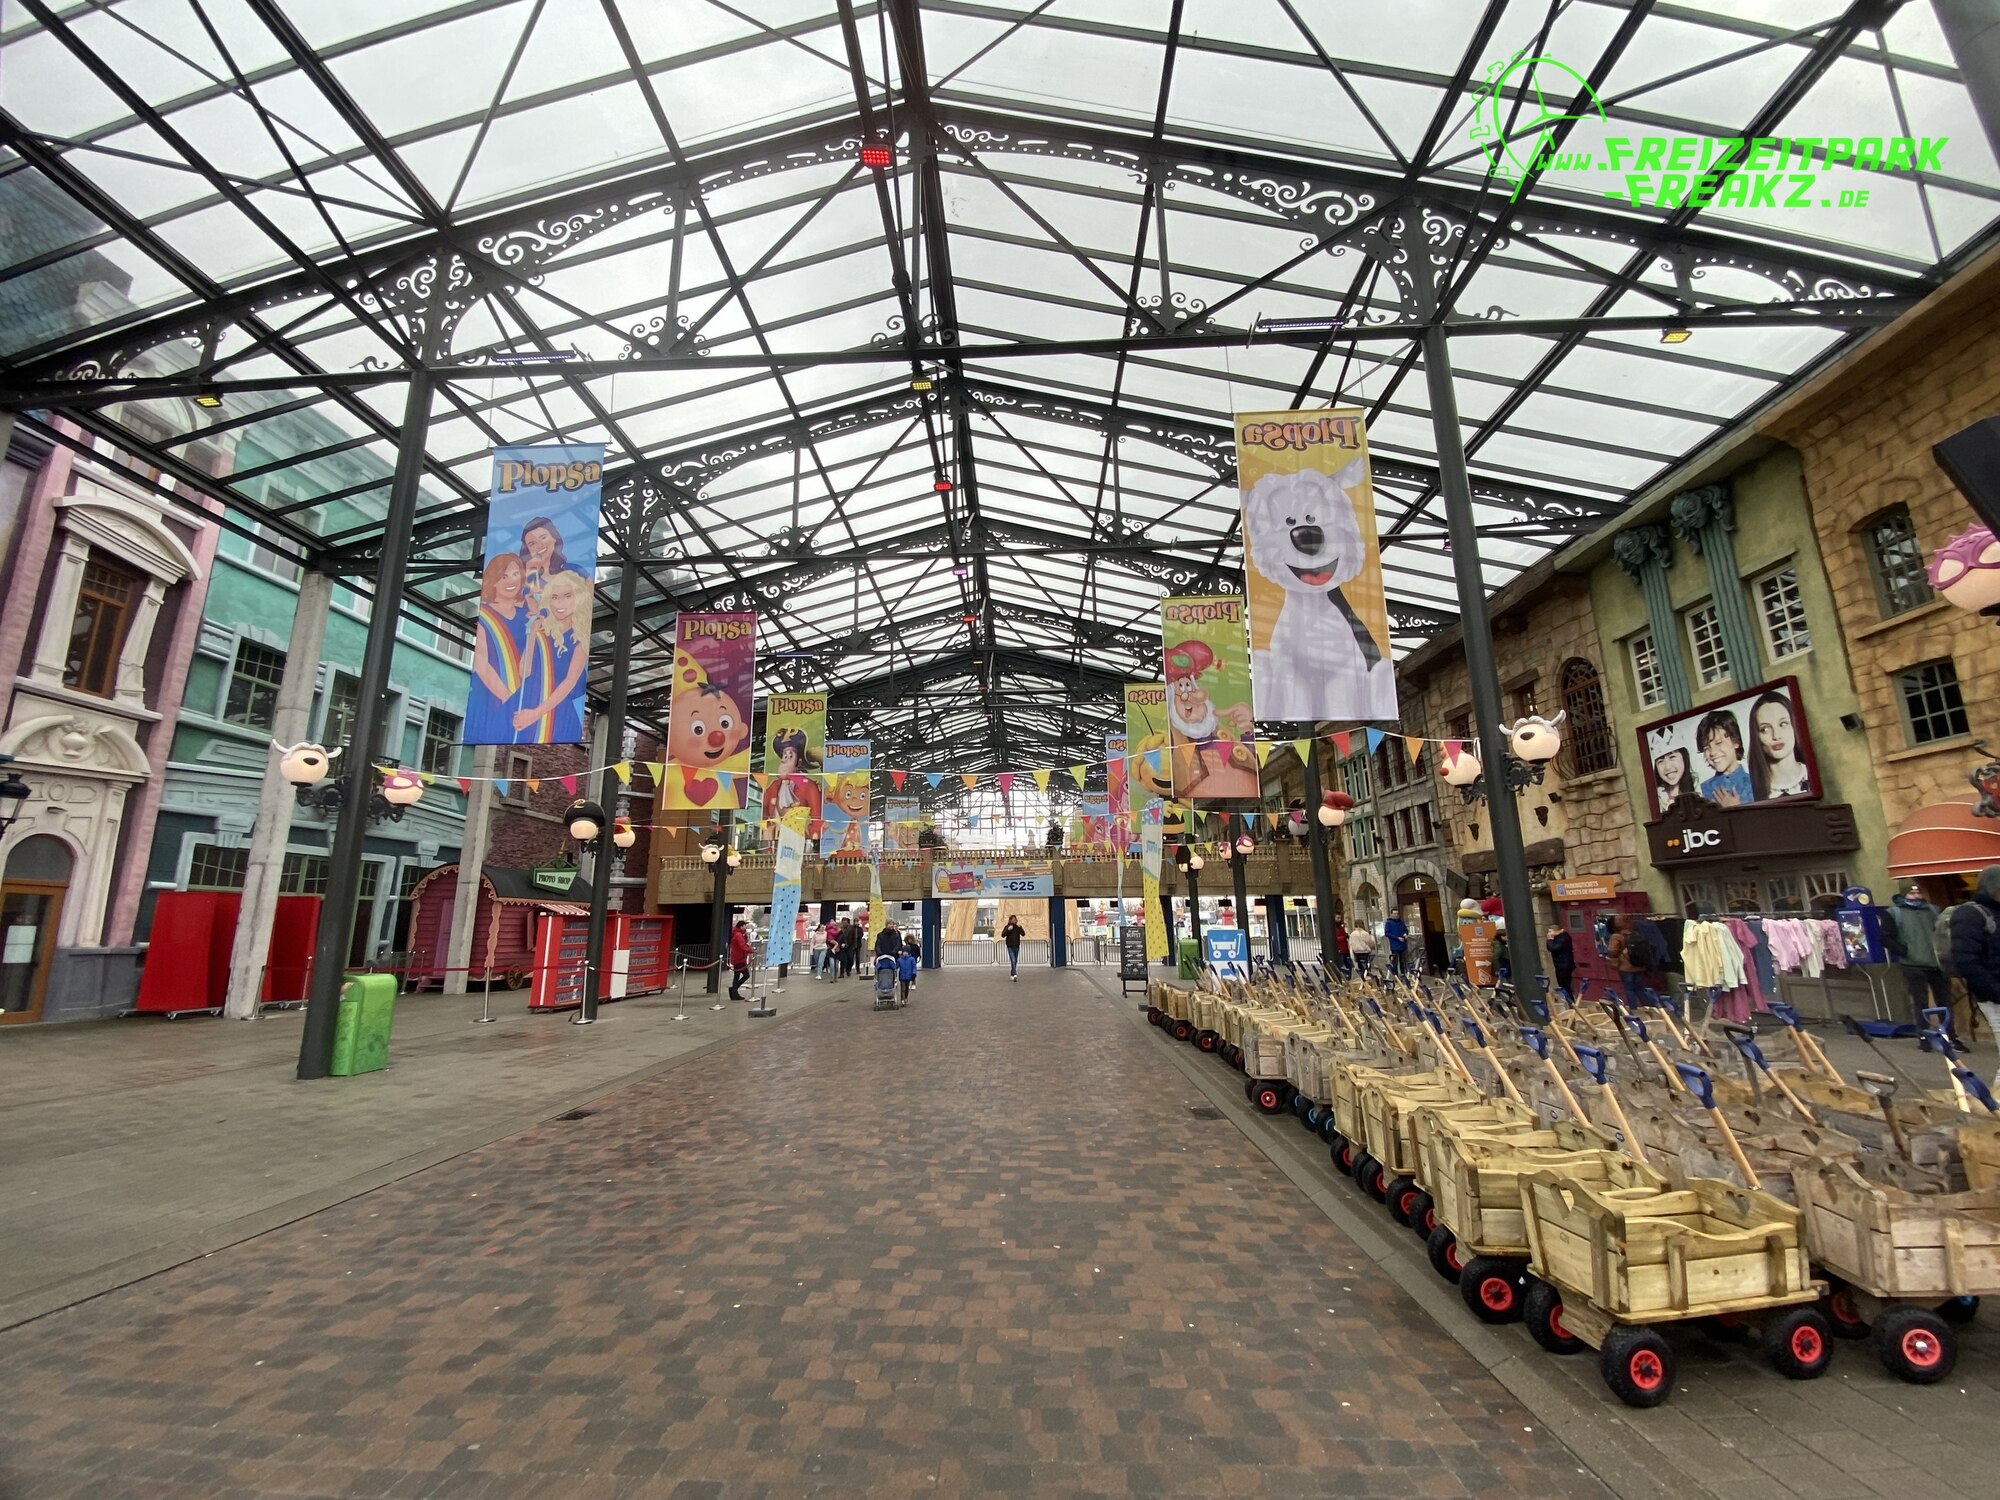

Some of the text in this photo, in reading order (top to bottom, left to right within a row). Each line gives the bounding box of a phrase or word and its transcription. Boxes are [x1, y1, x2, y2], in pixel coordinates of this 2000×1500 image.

[496, 460, 602, 493] Plopsa
[681, 619, 753, 641] Plopsa
[771, 698, 824, 715] Plopsa
[825, 744, 868, 758] Plopsa
[1682, 828, 1721, 854] jbc
[538, 874, 571, 884] PHOTO SHOP
[1003, 881, 1034, 891] -€25
